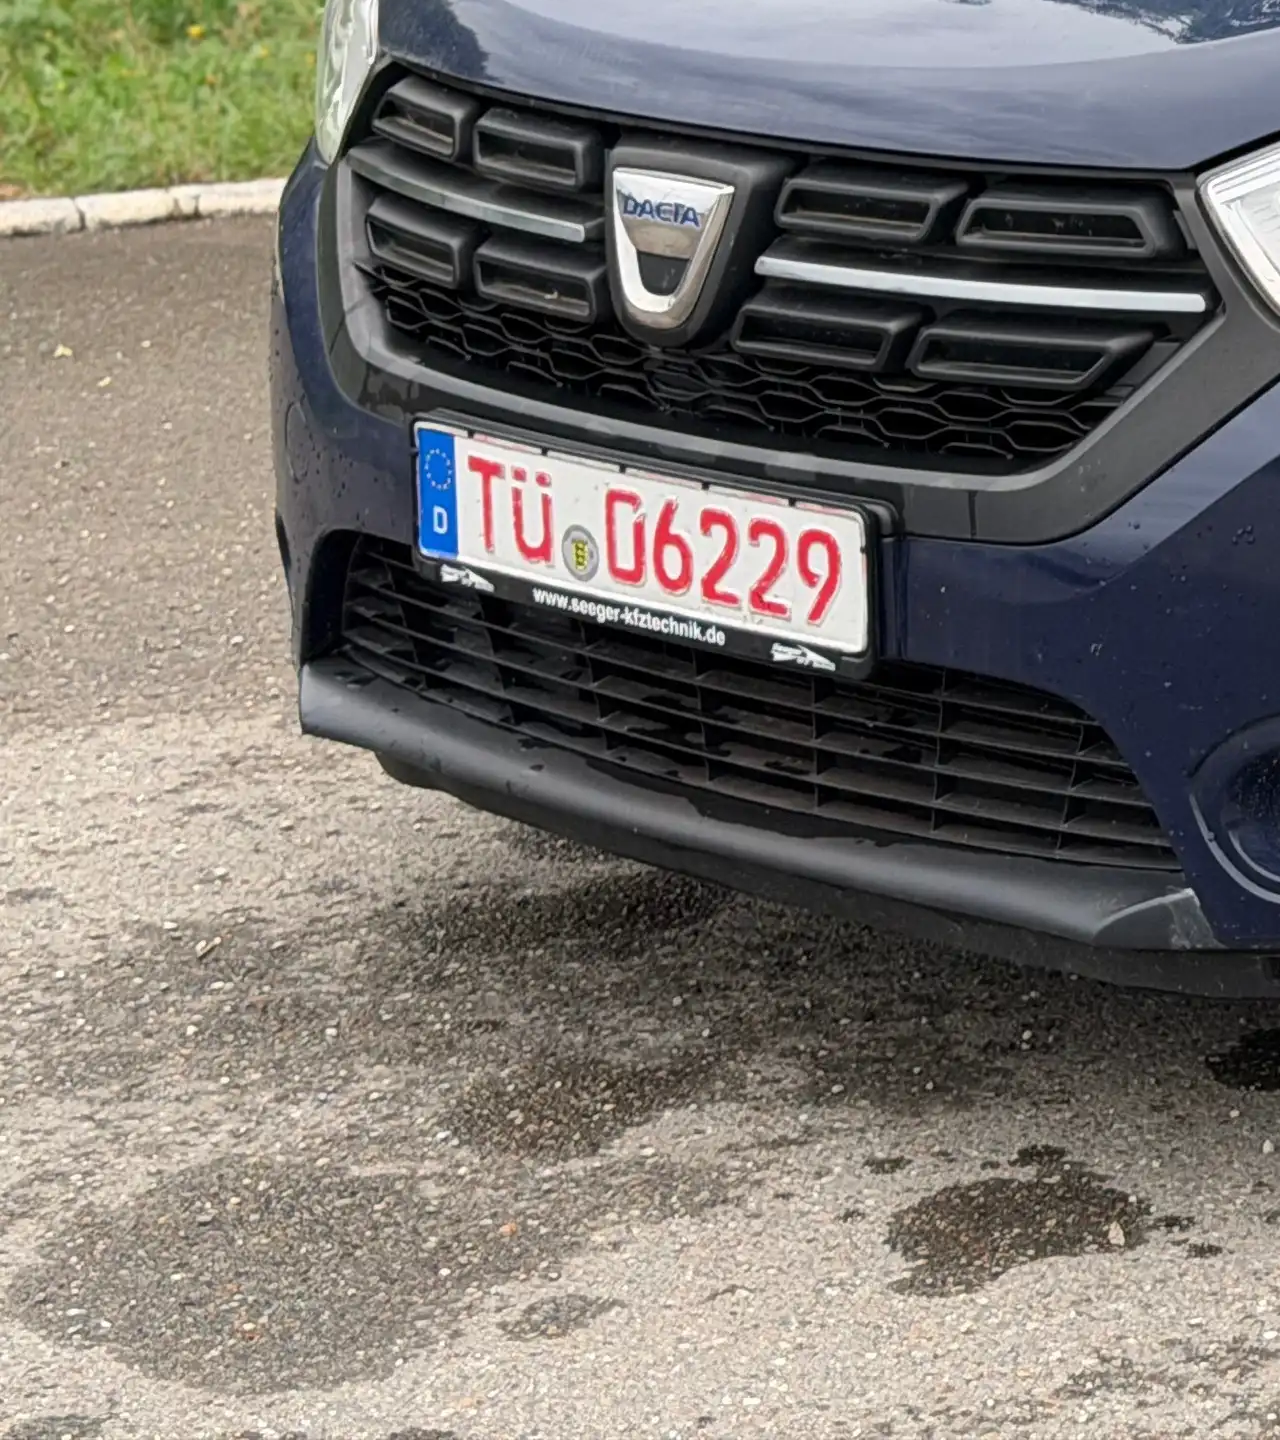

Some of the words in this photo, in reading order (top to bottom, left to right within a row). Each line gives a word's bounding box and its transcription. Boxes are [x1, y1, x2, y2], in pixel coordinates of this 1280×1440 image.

[622, 193, 701, 228] DACIA
[432, 504, 449, 536] D
[468, 455, 556, 567] TÜ
[603, 488, 844, 627] 06229
[532, 586, 726, 648] www.seeger-kfztechnik.de
